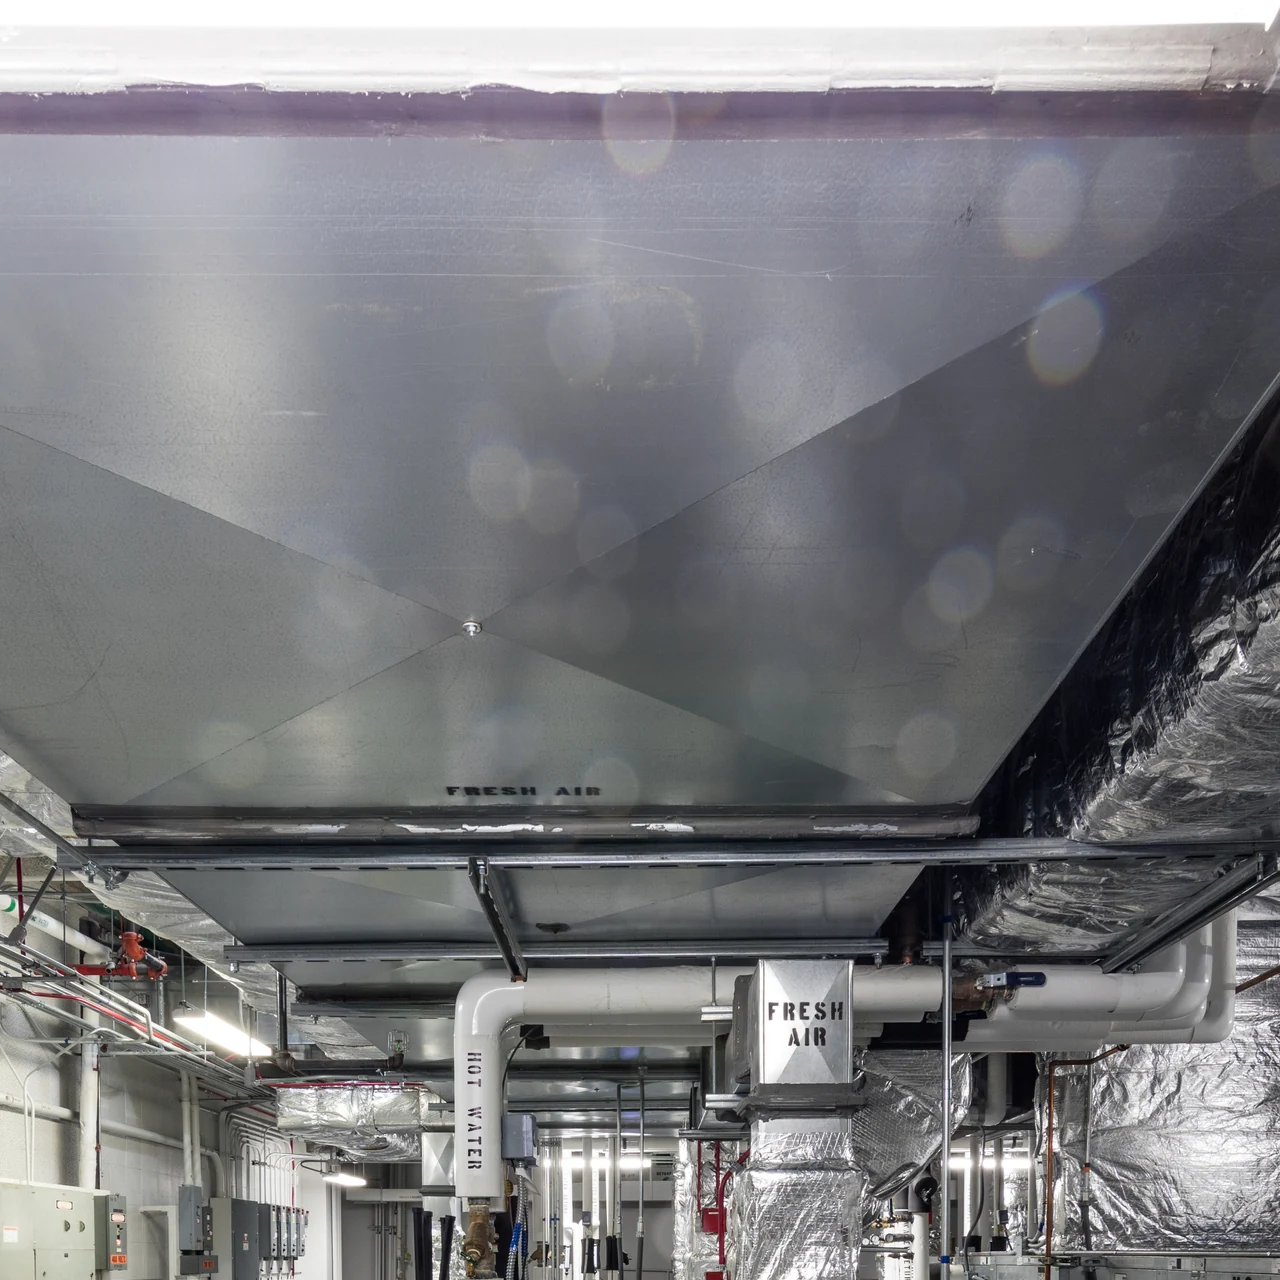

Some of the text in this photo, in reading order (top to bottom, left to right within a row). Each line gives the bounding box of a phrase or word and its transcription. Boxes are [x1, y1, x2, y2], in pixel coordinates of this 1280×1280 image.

[446, 786, 601, 796] FRESH AIR
[768, 1001, 843, 1021] FRESH
[788, 1027, 827, 1047] AIR
[467, 1052, 482, 1169] HOT WATER
